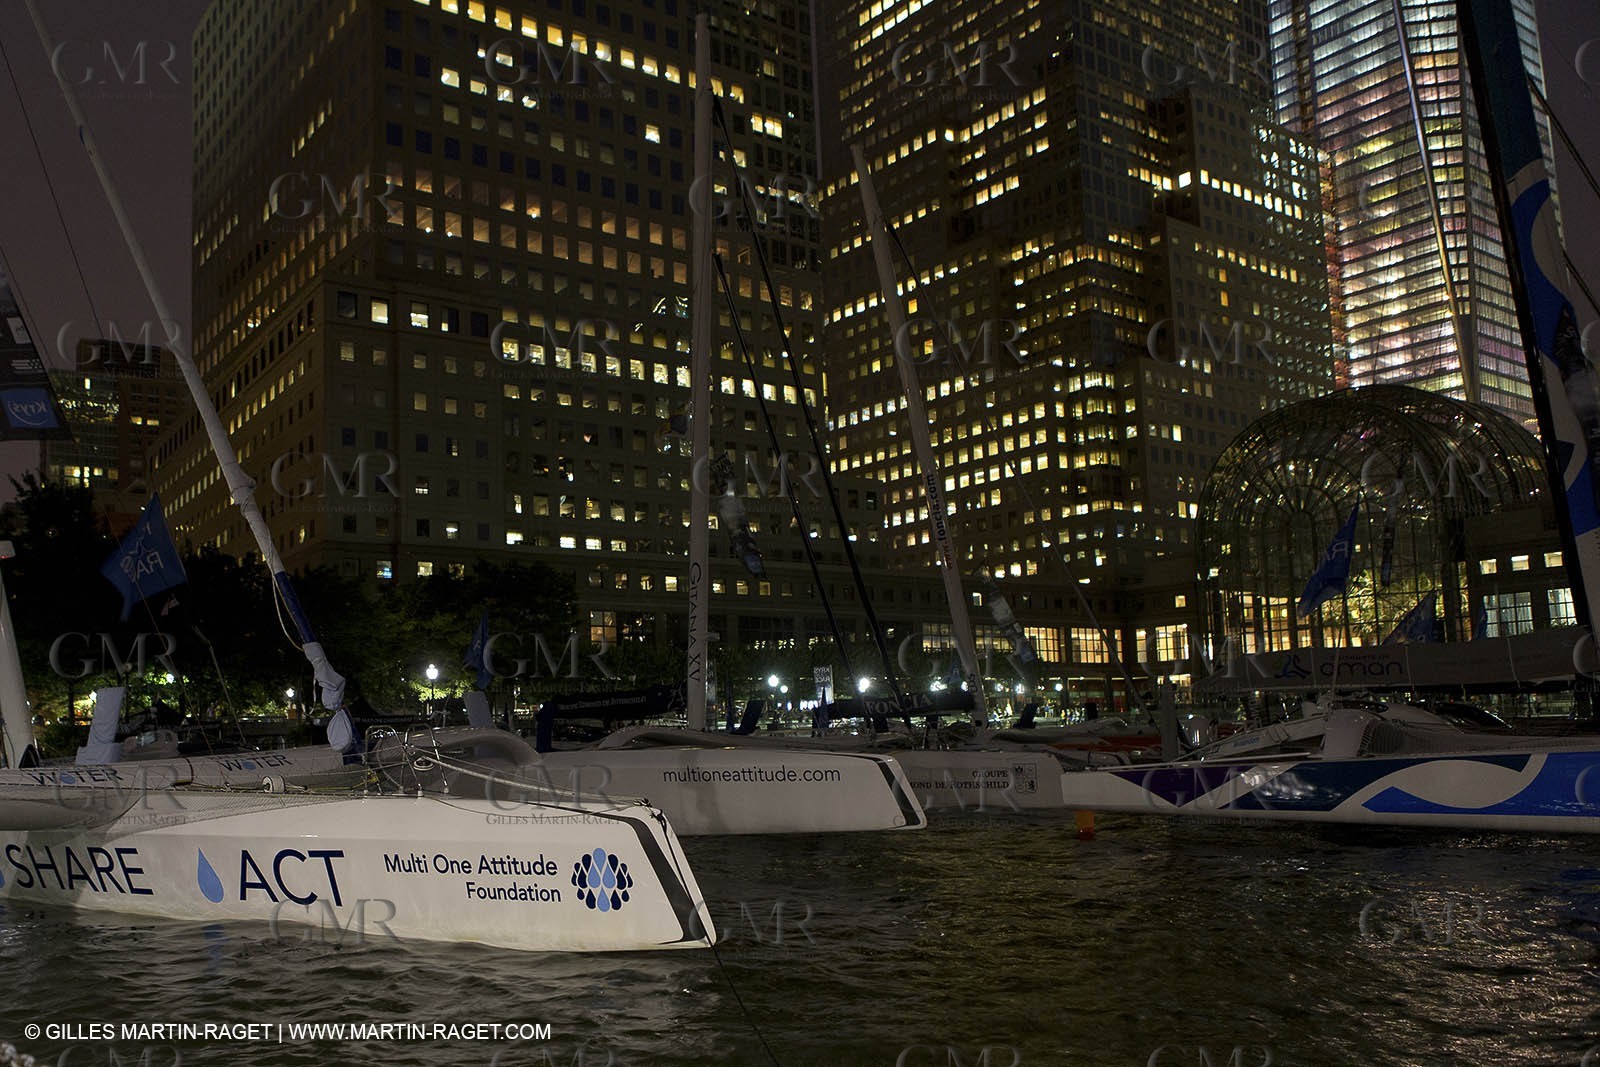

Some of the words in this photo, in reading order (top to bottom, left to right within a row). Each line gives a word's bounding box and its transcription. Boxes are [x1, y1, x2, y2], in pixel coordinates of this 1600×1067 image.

[663, 765, 841, 783] multioneattitude.com
[4, 844, 154, 896] SHARE
[239, 848, 345, 907] ACT
[383, 853, 429, 873] Multi
[433, 854, 472, 874] One
[477, 854, 558, 876] Attitude
[465, 881, 562, 902] Foundation
